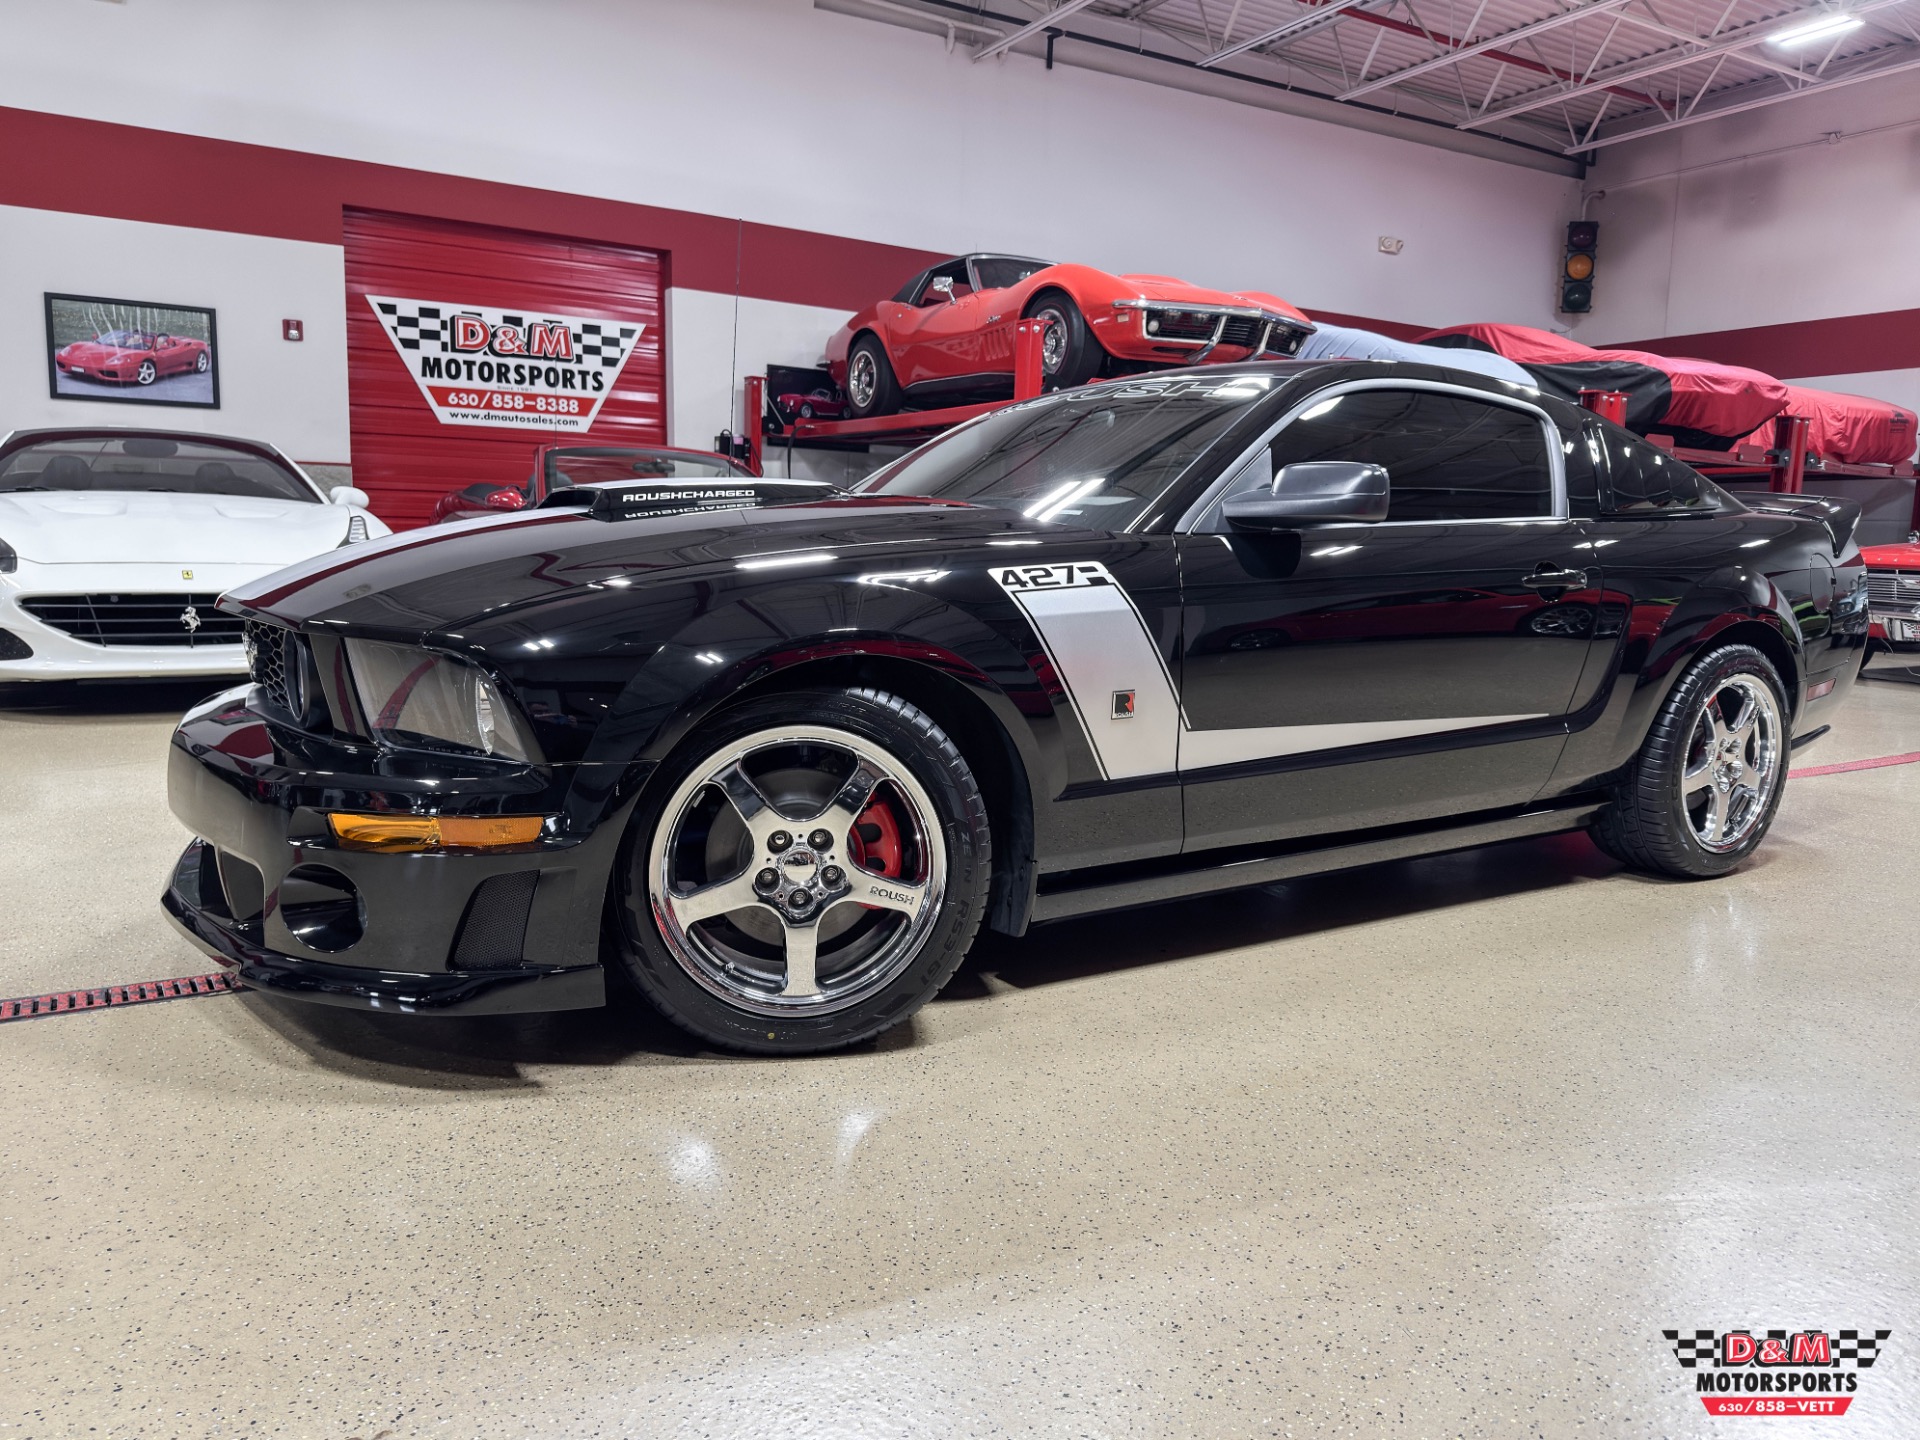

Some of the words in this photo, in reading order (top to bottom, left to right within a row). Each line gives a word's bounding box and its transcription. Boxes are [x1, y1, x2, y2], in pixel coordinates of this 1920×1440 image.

[450, 315, 574, 363] D&M
[421, 356, 604, 392] MOTORSPORTS
[448, 392, 580, 413] 630/858-8388
[449, 411, 579, 427] www.dmautosales.com
[623, 489, 755, 502] ROUSHCHARGED
[869, 886, 915, 906] ROUSH
